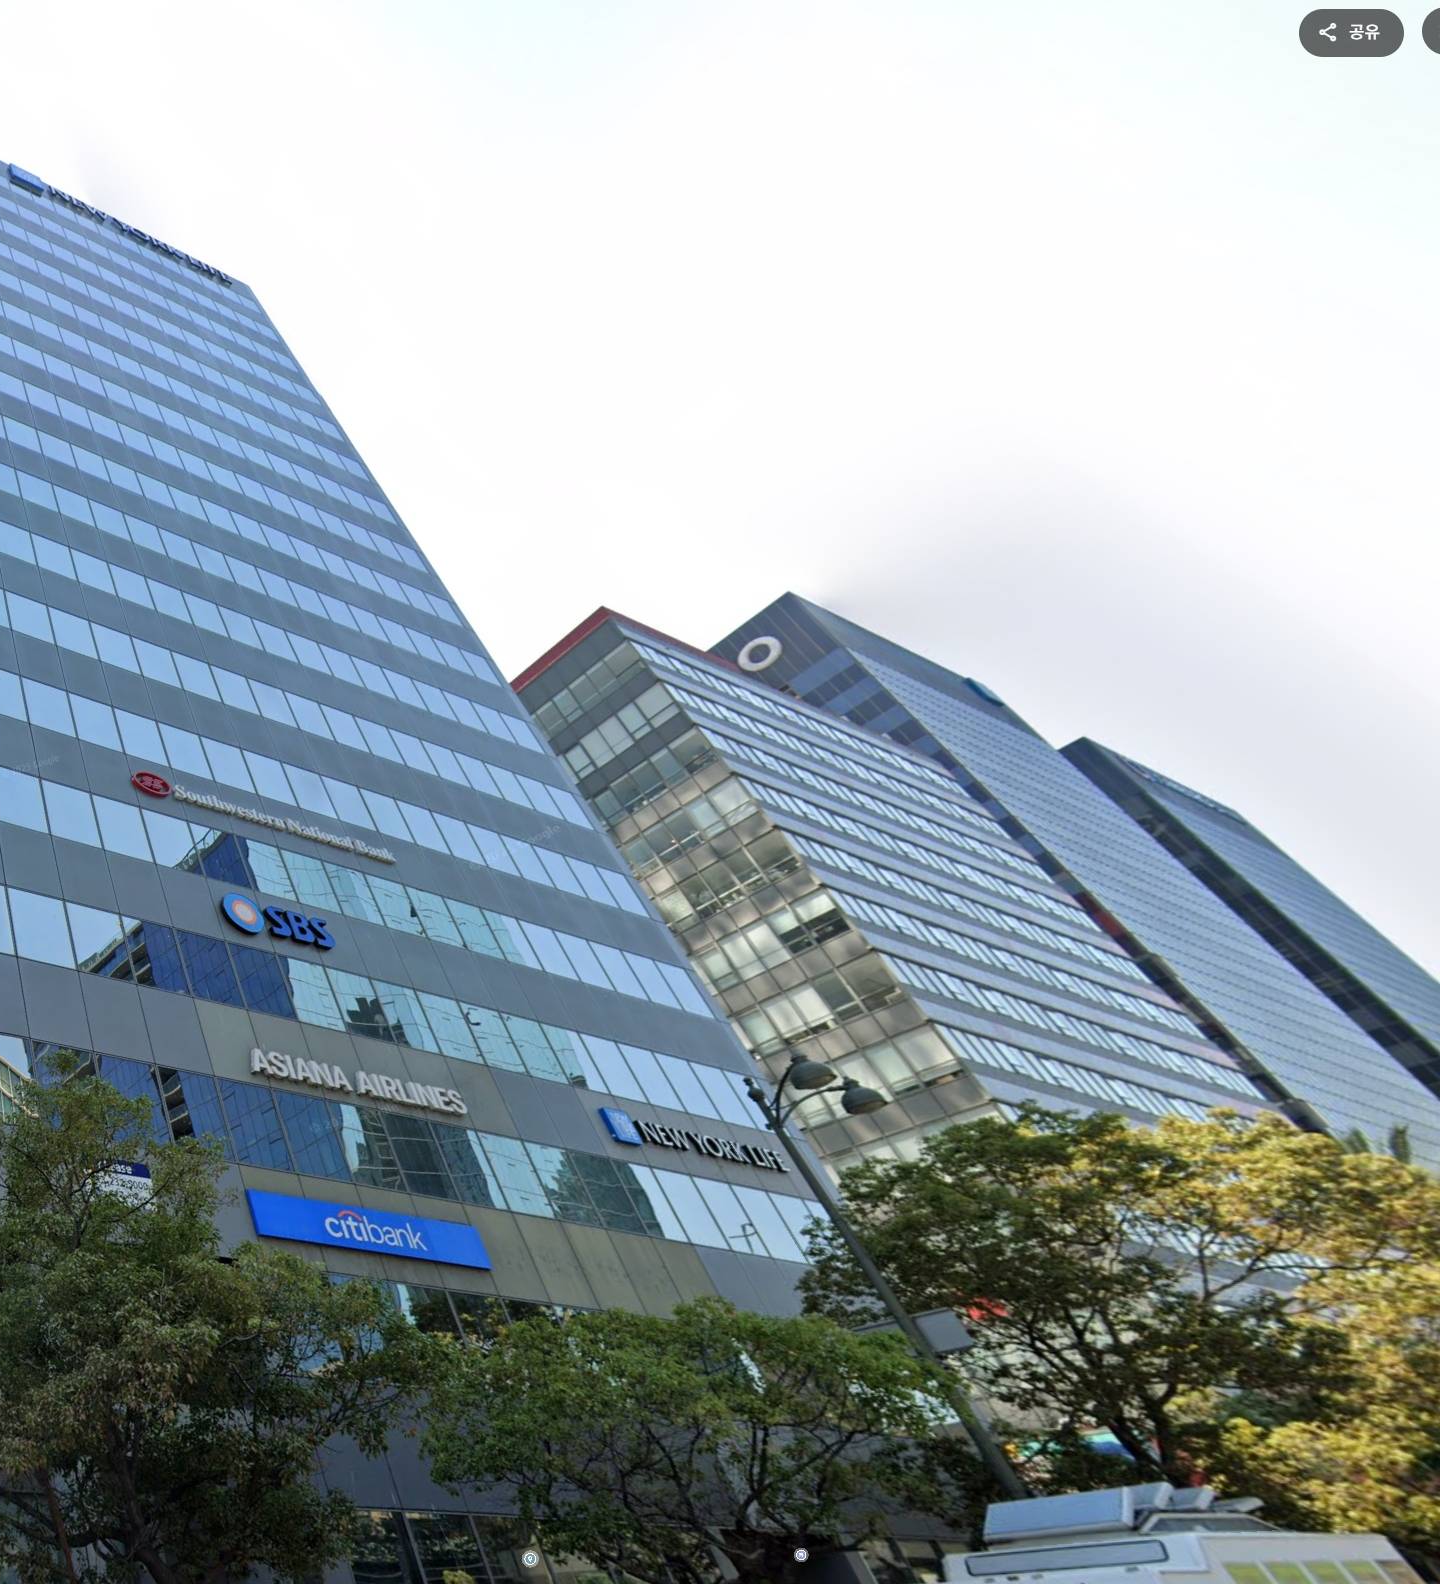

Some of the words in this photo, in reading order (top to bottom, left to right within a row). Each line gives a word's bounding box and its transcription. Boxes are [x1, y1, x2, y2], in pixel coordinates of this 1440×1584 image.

[174, 784, 286, 831] Southwestern
[283, 817, 354, 852] National
[354, 838, 397, 865] Bank
[263, 905, 337, 950] SBS
[250, 1047, 353, 1093] ASIANA
[355, 1070, 468, 1115] AIRLINES
[635, 1120, 690, 1151] NEW
[690, 1131, 751, 1164] YORK
[745, 1144, 791, 1173] LIFE
[324, 1213, 428, 1251] citibank
